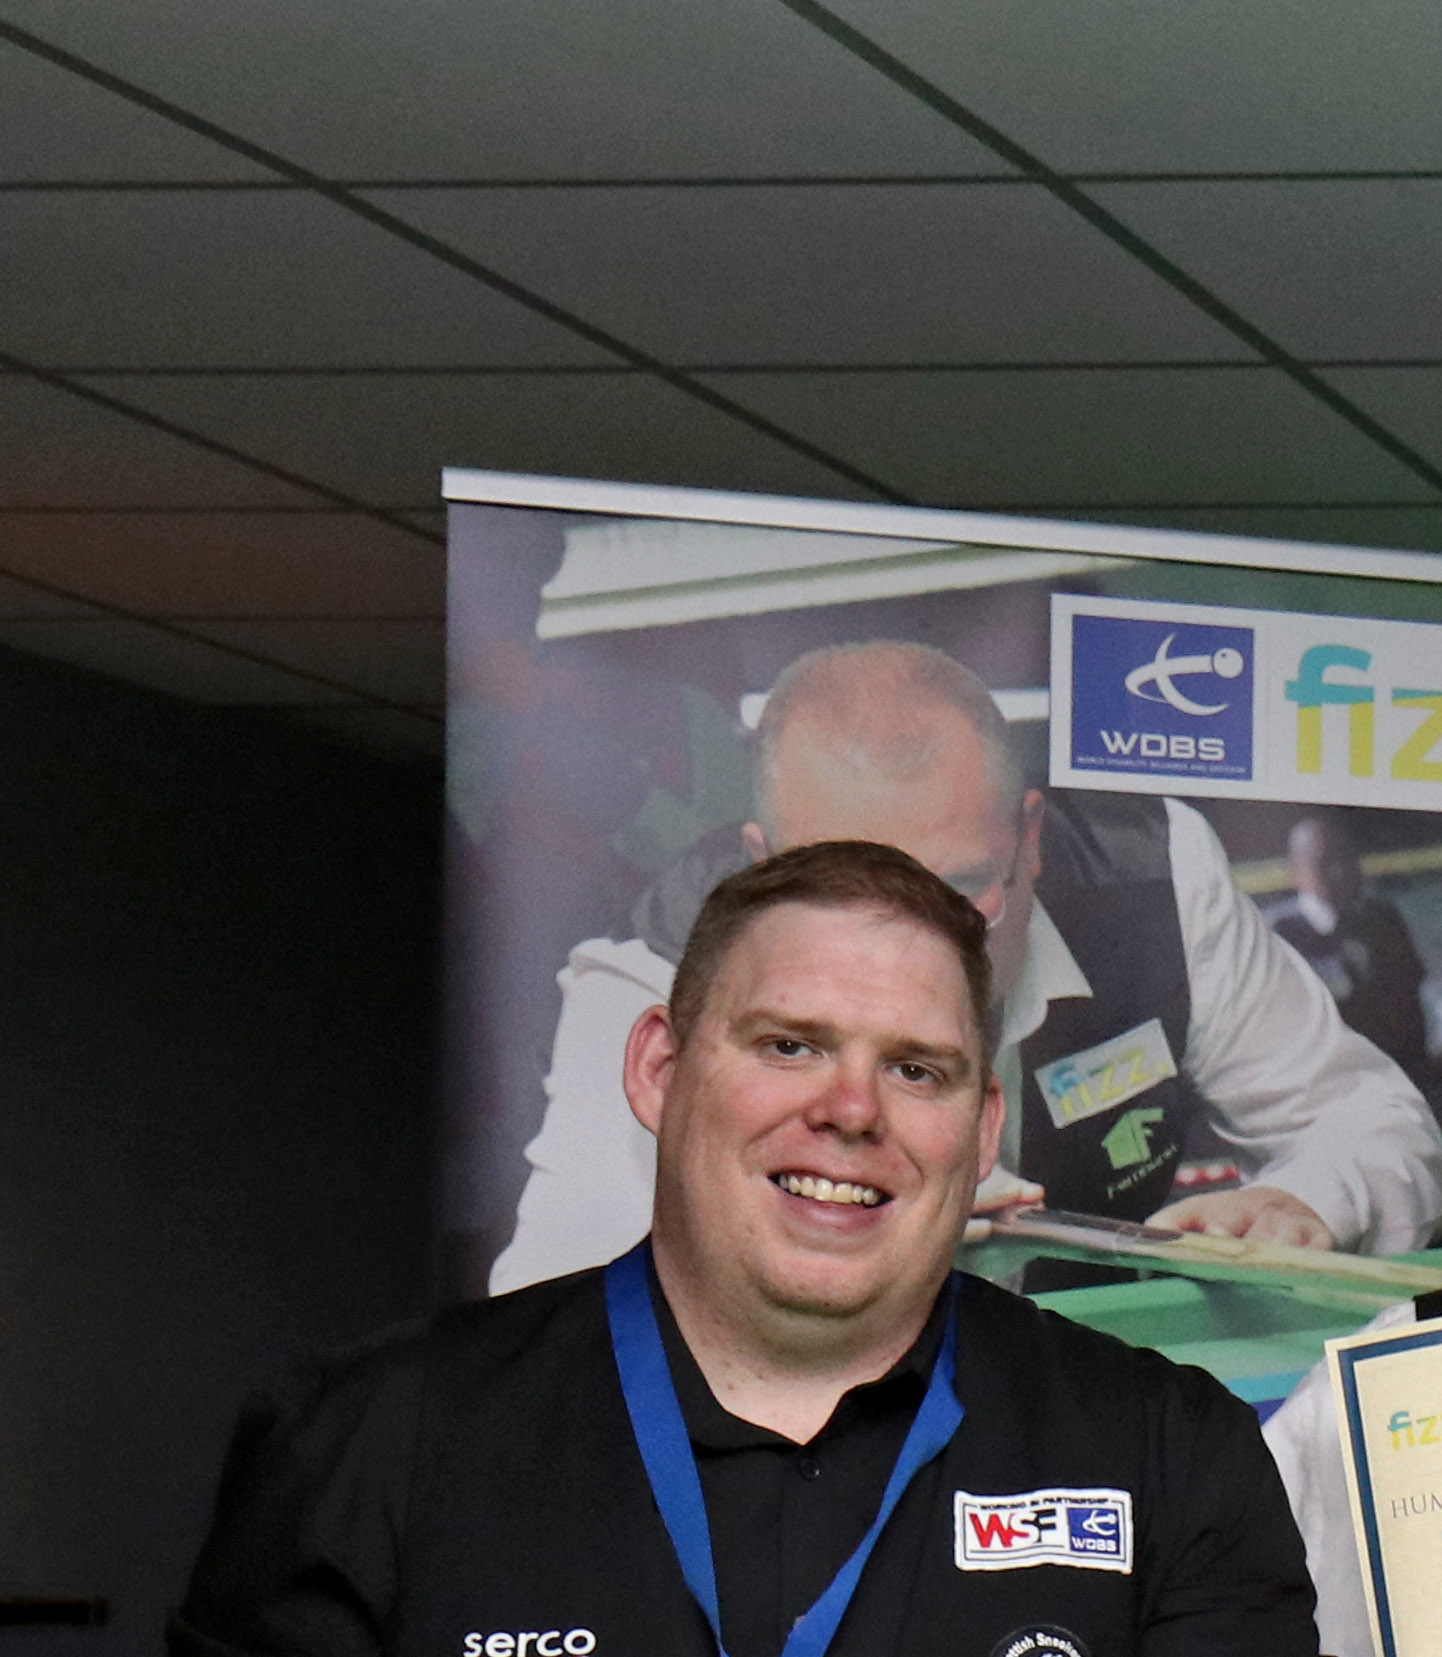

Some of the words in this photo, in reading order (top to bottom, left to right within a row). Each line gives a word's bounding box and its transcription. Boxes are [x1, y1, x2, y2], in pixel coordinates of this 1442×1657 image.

[1100, 730, 1225, 761] WDBS
[1050, 1045, 1169, 1117] fizz.
[969, 1508, 1057, 1547] WSF
